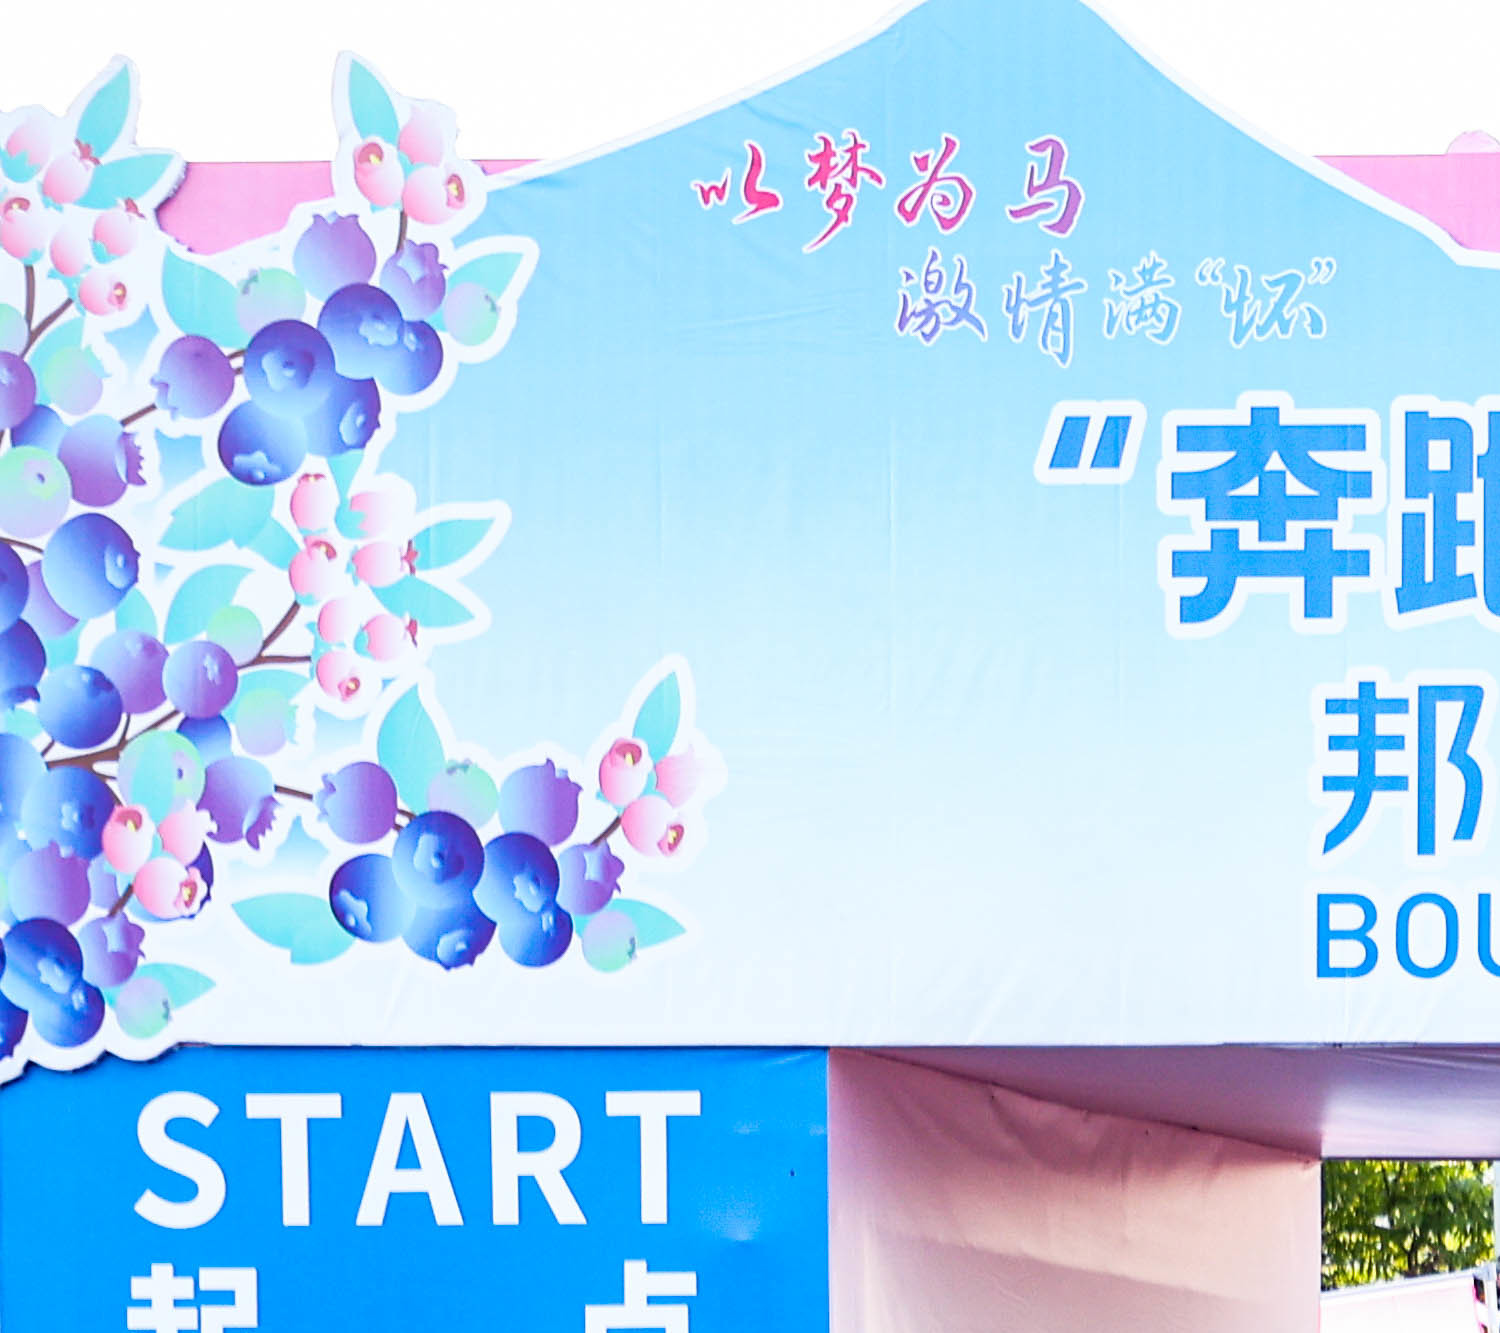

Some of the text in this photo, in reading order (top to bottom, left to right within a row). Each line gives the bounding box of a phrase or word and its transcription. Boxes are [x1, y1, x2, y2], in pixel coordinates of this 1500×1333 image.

[691, 131, 1088, 254] 以梦为马
[133, 1090, 701, 1229] START
